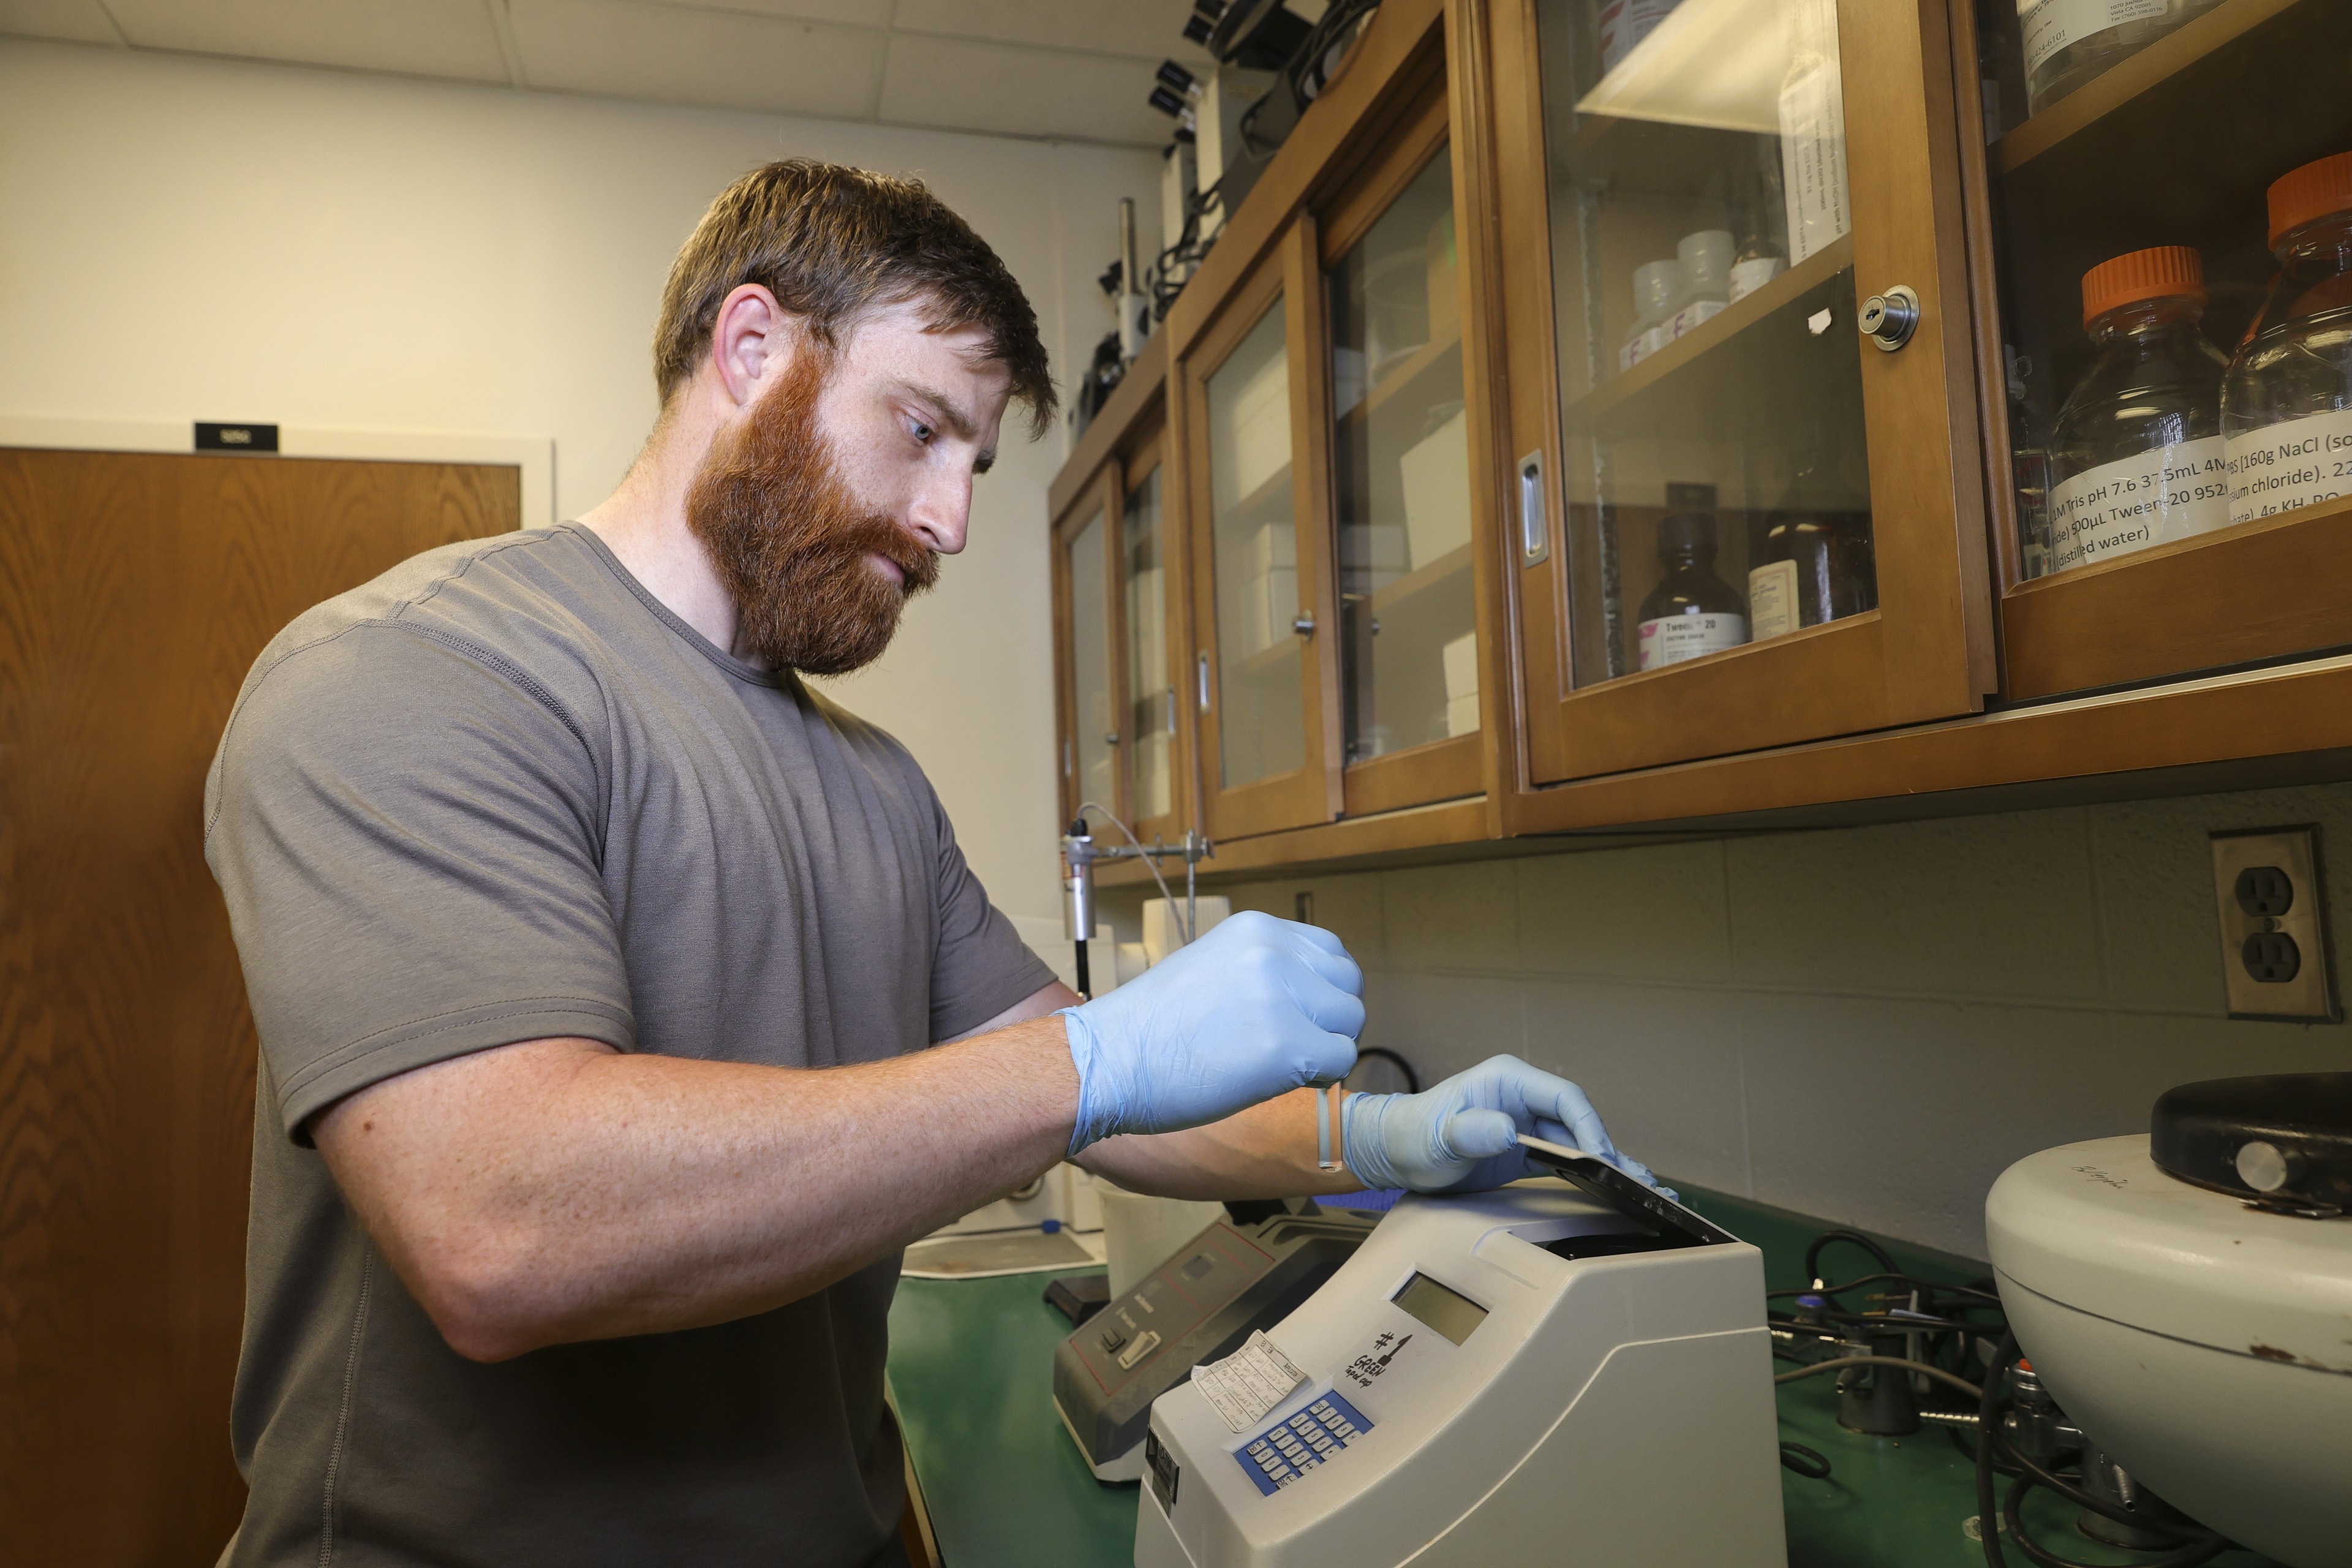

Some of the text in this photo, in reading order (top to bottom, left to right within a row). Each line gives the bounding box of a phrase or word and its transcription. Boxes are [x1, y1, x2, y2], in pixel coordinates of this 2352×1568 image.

[2241, 450, 2274, 473] [160g
[2279, 437, 2318, 459] NaCl
[2252, 466, 2326, 494] chloride).
[2066, 496, 2084, 512] Tris
[2088, 486, 2107, 506] pH
[2111, 479, 2136, 496] 7.6
[2072, 512, 2107, 536] 500µL
[2108, 490, 2190, 521] Tween-20
[2098, 525, 2149, 549] water)
[1354, 1354, 1386, 1376] GREEN
